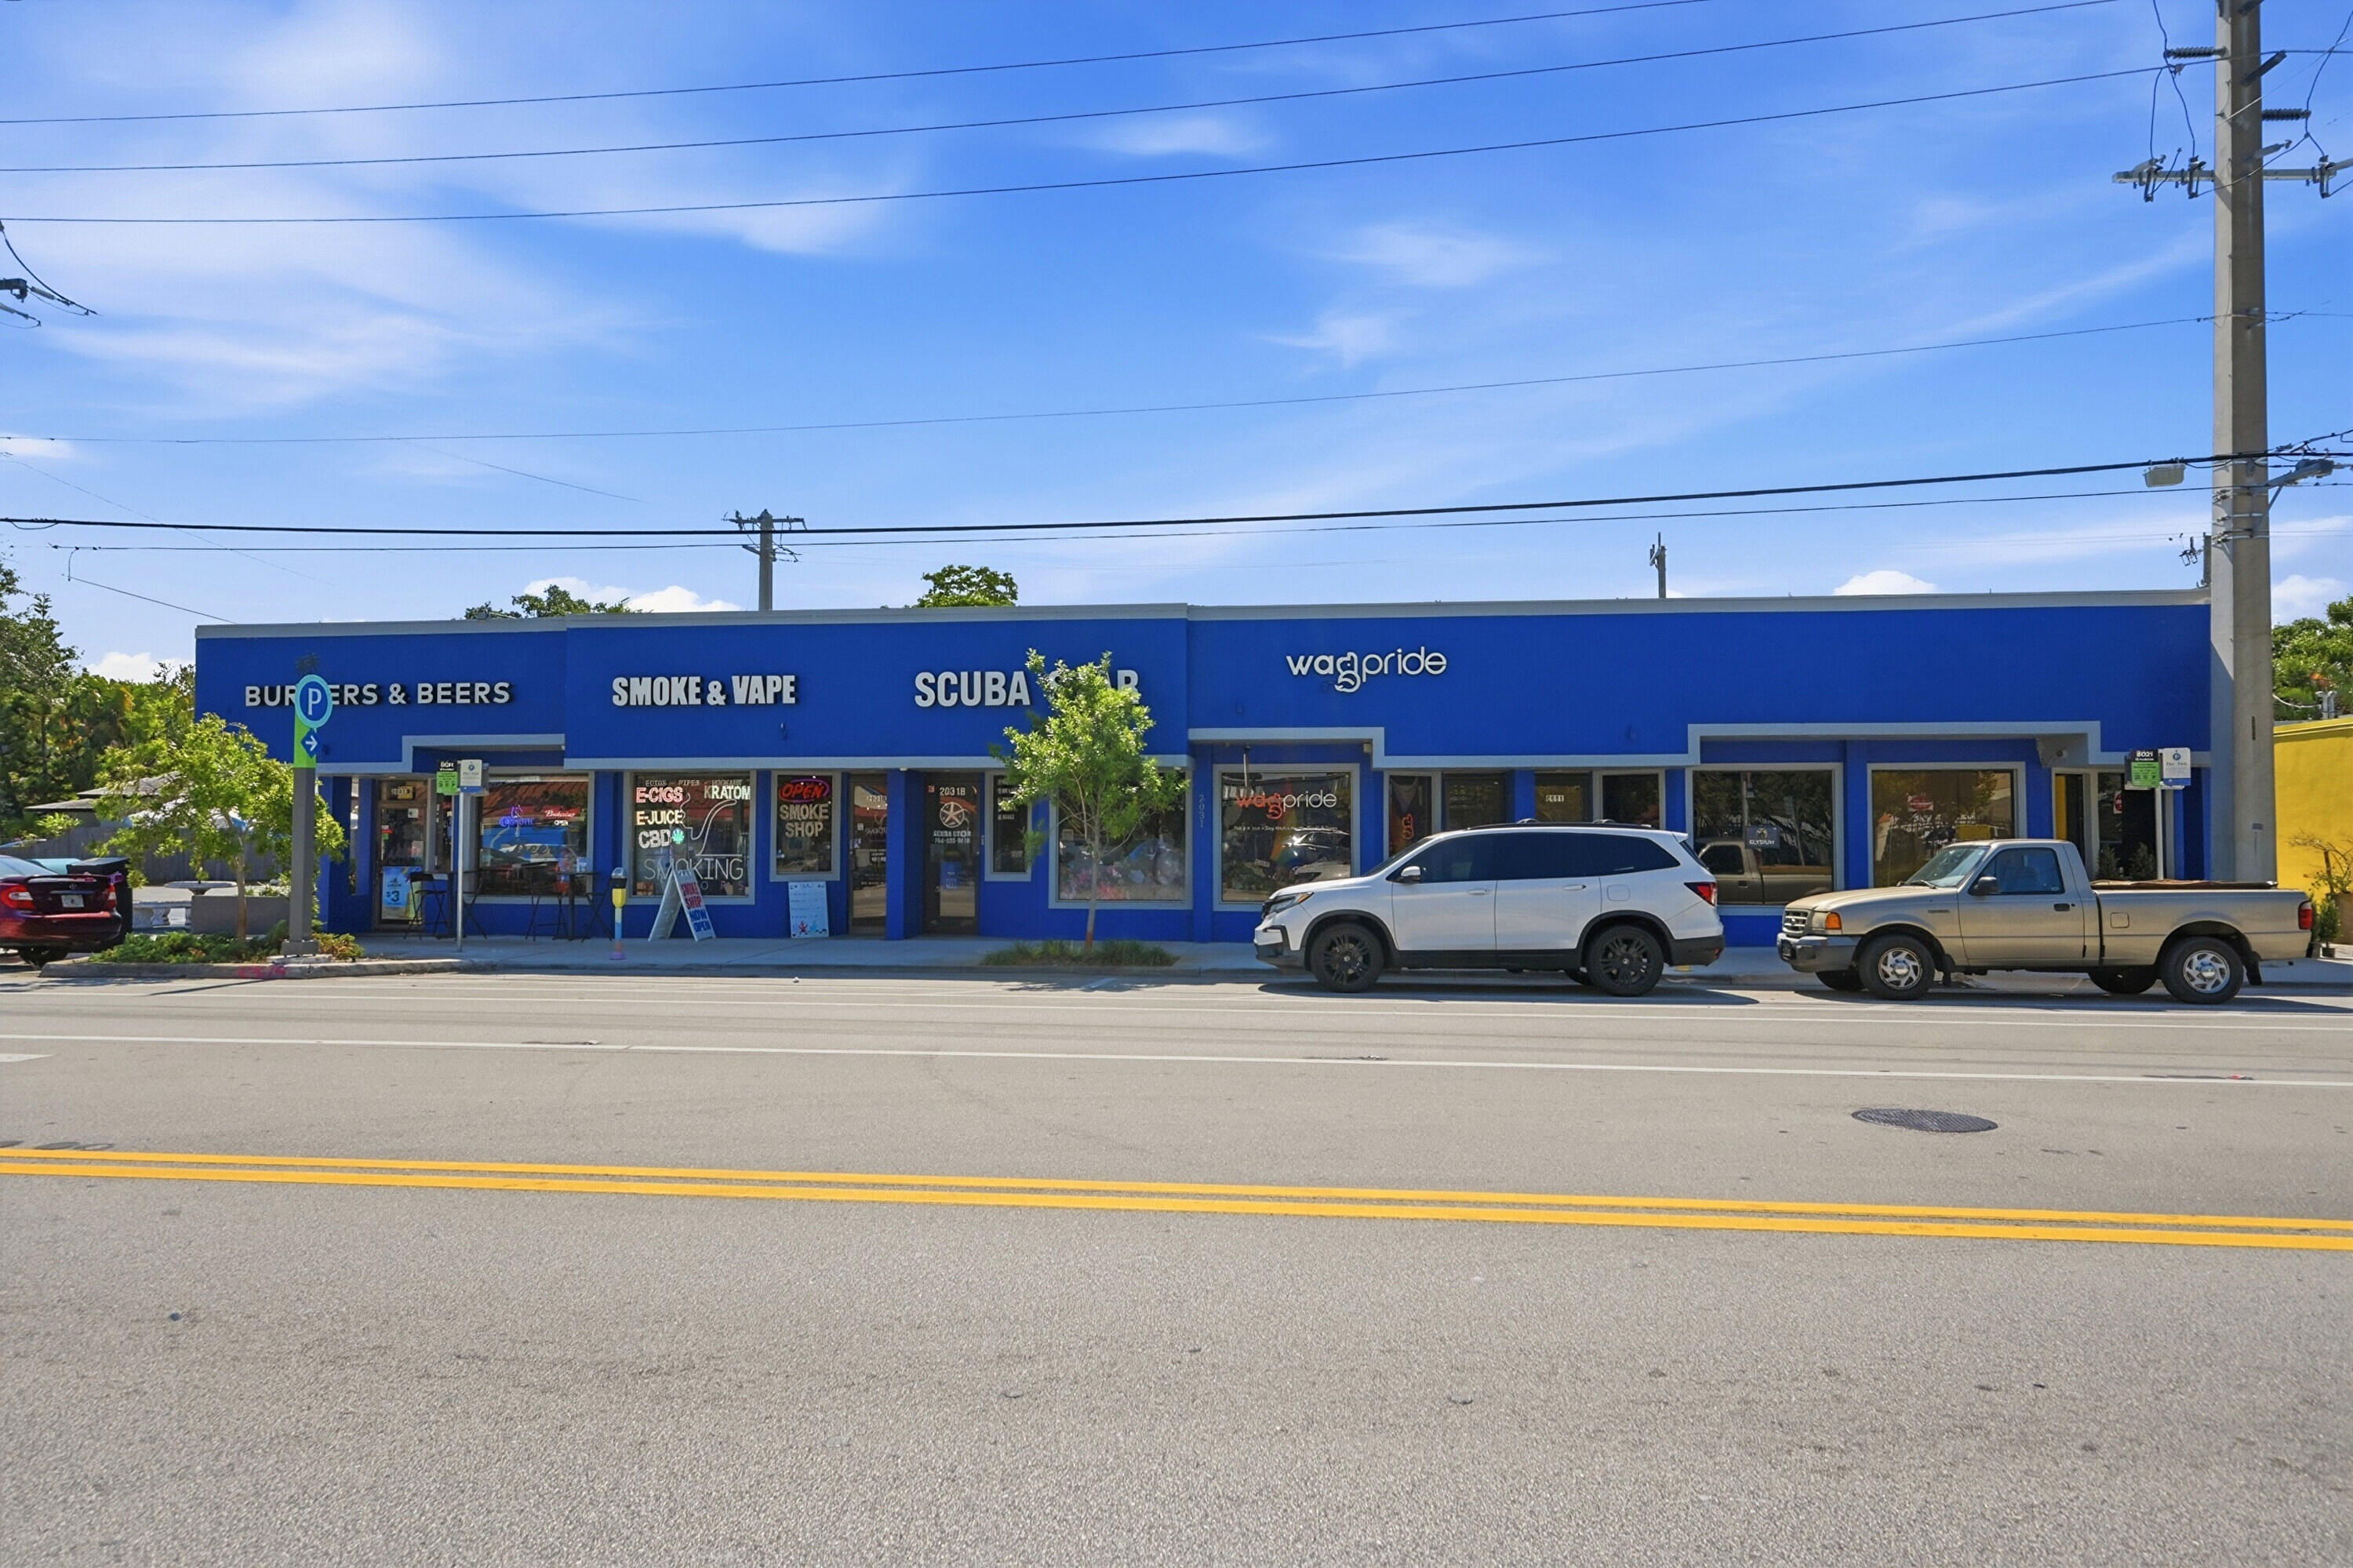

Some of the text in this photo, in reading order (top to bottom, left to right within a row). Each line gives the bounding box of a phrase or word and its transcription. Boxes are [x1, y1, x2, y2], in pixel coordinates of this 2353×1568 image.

[1286, 646, 1447, 693] wagpride
[245, 682, 510, 707] BURERS & BEERS
[613, 675, 795, 706] SMOKE & VAPE
[915, 671, 1031, 707] SCUBA
[307, 688, 322, 715] P
[635, 786, 683, 803] E-CIGS
[704, 785, 751, 800] KRATOM
[782, 784, 824, 798] OPEN
[780, 803, 829, 820] SMOKE
[1236, 790, 1337, 819] wagpride
[636, 809, 683, 825] E-JUICE
[638, 829, 671, 849] CBD
[785, 821, 824, 838] SHOP
[643, 858, 744, 880] SMOKING
